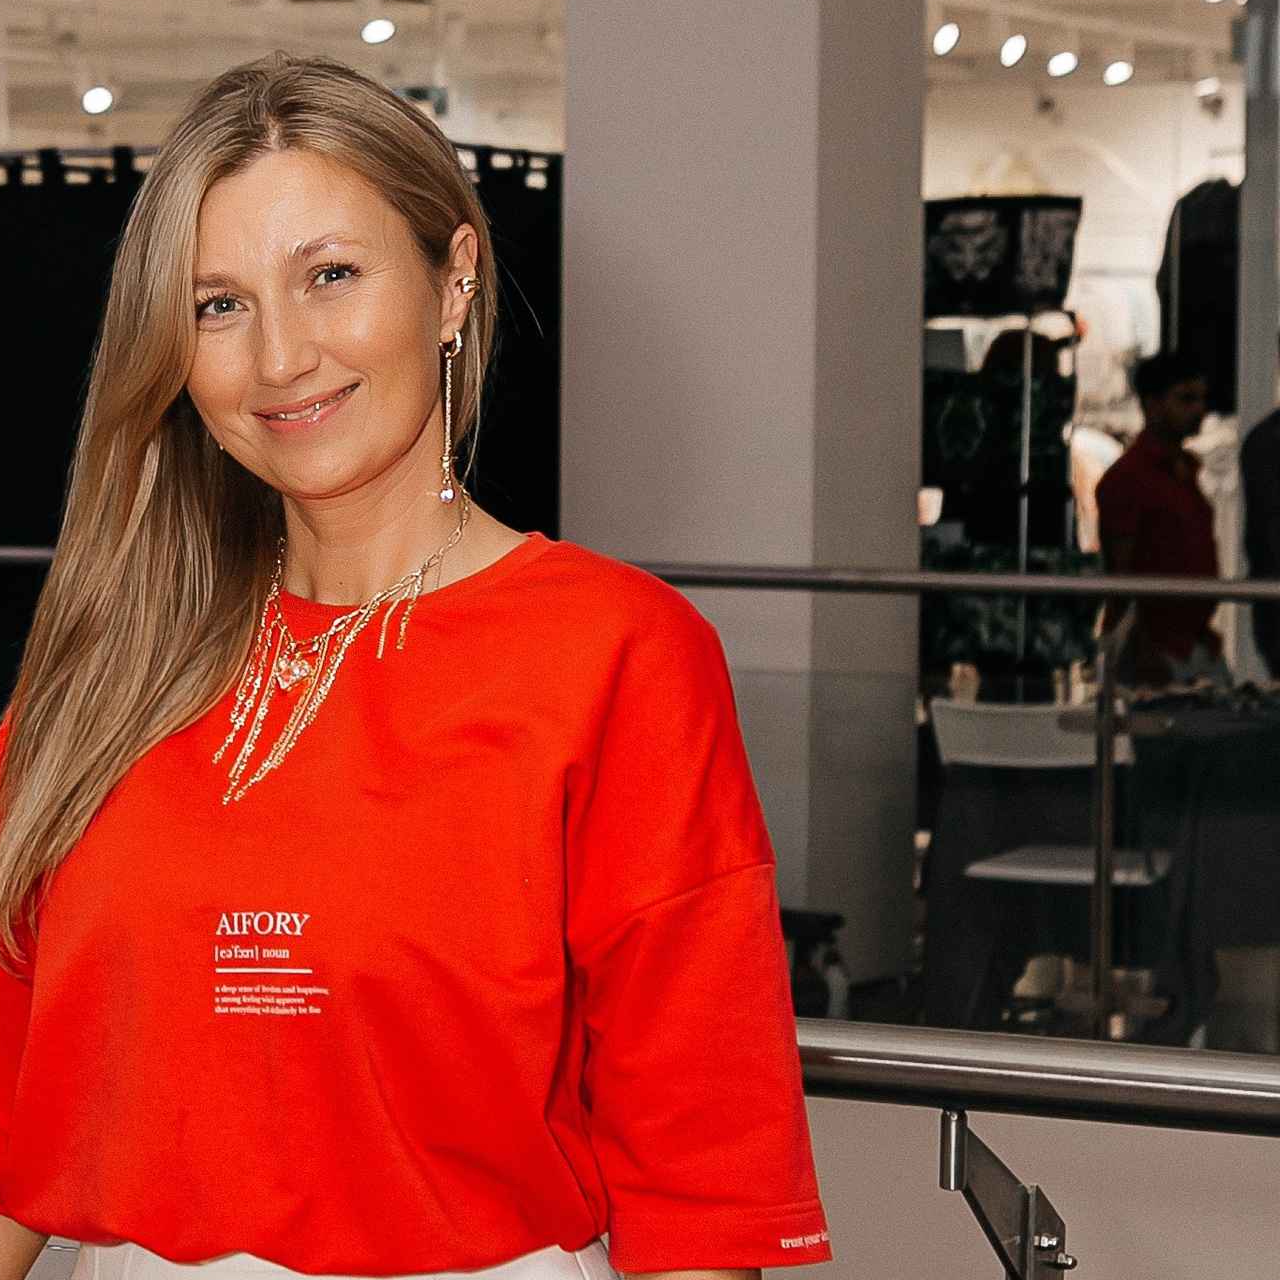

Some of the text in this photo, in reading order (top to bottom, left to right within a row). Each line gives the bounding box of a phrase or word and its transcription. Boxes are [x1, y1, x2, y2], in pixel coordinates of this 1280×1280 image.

[215, 911, 311, 936] AIFORY
[261, 948, 290, 959] noun
[780, 1237, 804, 1249] trust
